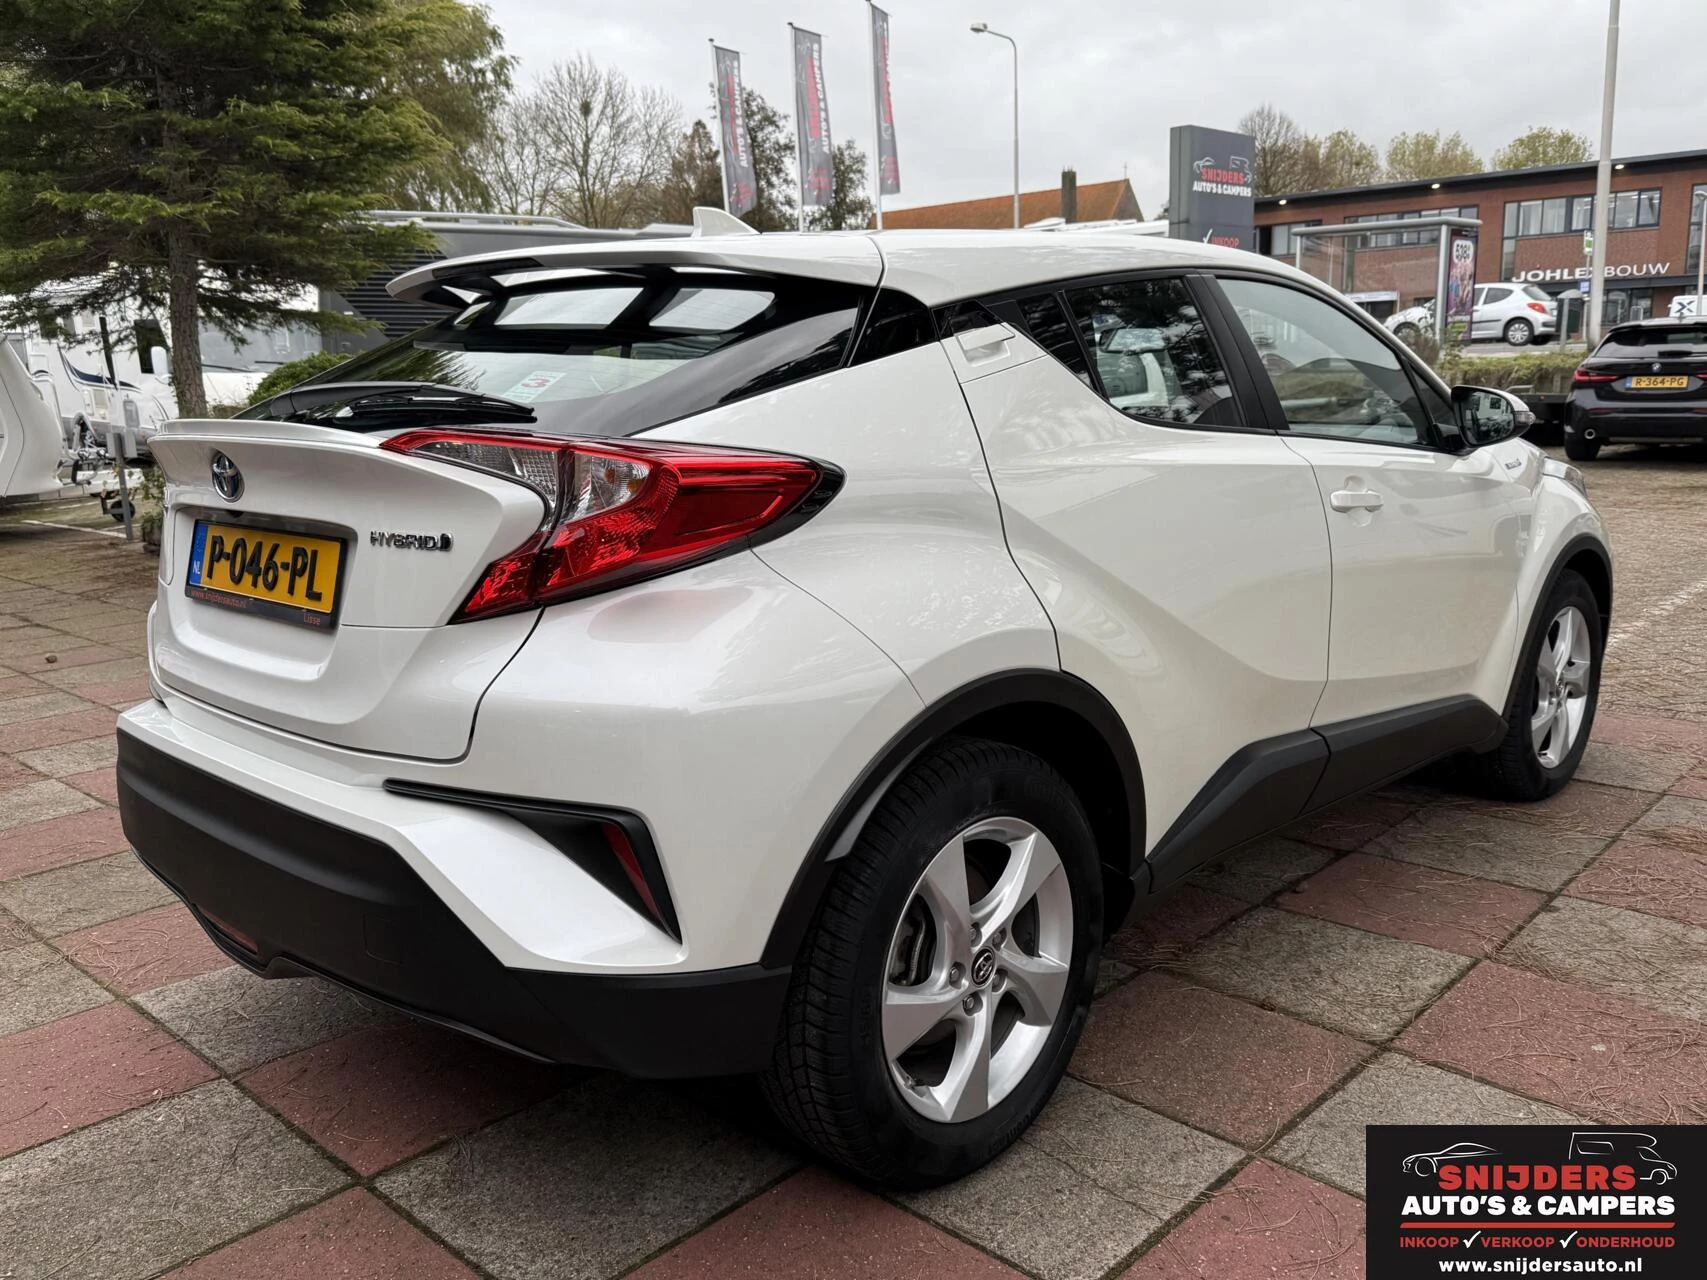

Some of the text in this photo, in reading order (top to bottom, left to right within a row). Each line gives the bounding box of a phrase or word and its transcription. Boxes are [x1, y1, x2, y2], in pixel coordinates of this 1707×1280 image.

[1201, 168, 1245, 184] SNIJDERS
[1192, 181, 1252, 197] AUTO'S & CAMPERS
[1604, 262, 1670, 278] BOUW
[1635, 377, 1685, 386] R-364-PG
[370, 531, 438, 551] HYBRID
[206, 535, 323, 602] P-046-PL
